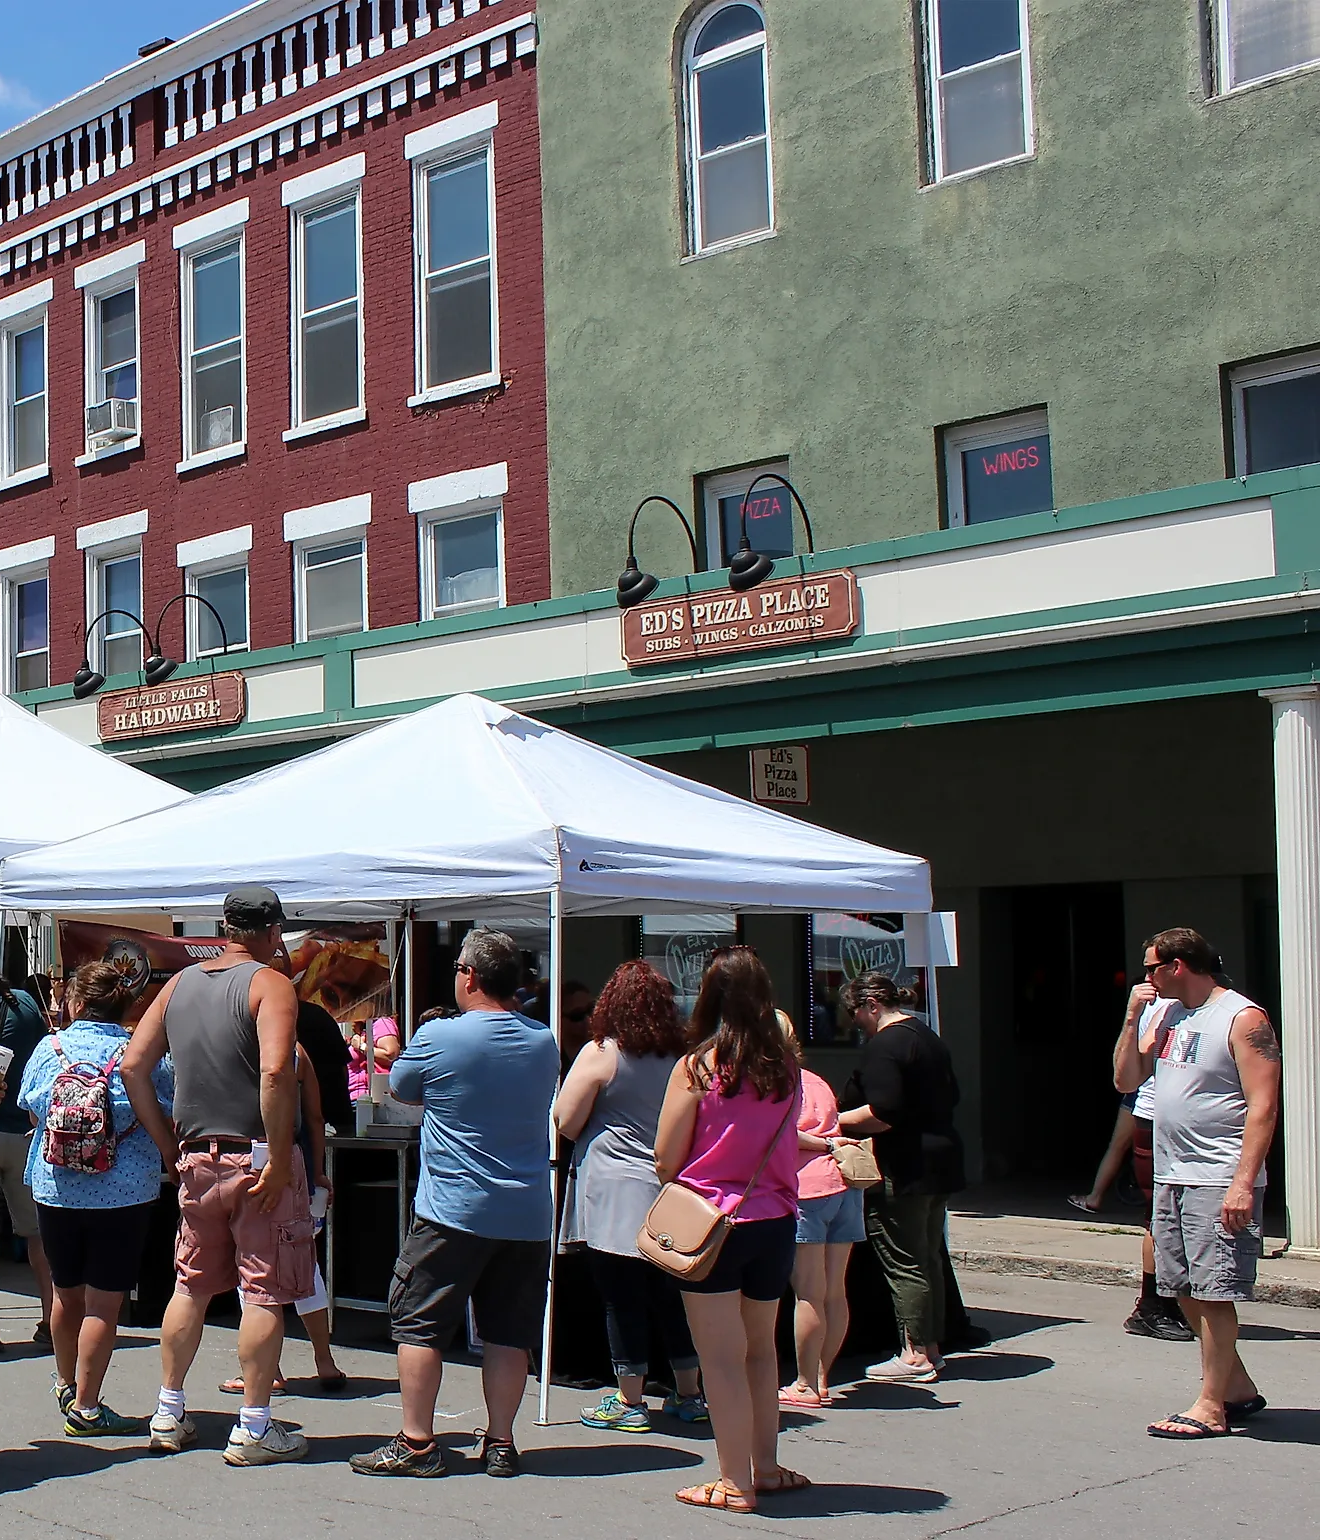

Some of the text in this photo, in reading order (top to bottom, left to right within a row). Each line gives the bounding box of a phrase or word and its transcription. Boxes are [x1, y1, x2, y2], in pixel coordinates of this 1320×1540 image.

[982, 446, 1039, 475] WINGS
[740, 497, 781, 519] PIZZA
[640, 584, 830, 636] ED'S PIZZA PLACE
[645, 614, 824, 653] SUBS WINGS CALZONES
[125, 685, 209, 709] LITTLE FALLS
[113, 699, 221, 731] HARDWARE
[770, 748, 793, 764] Ed's
[764, 763, 797, 782] Pizza
[766, 781, 797, 798] Place
